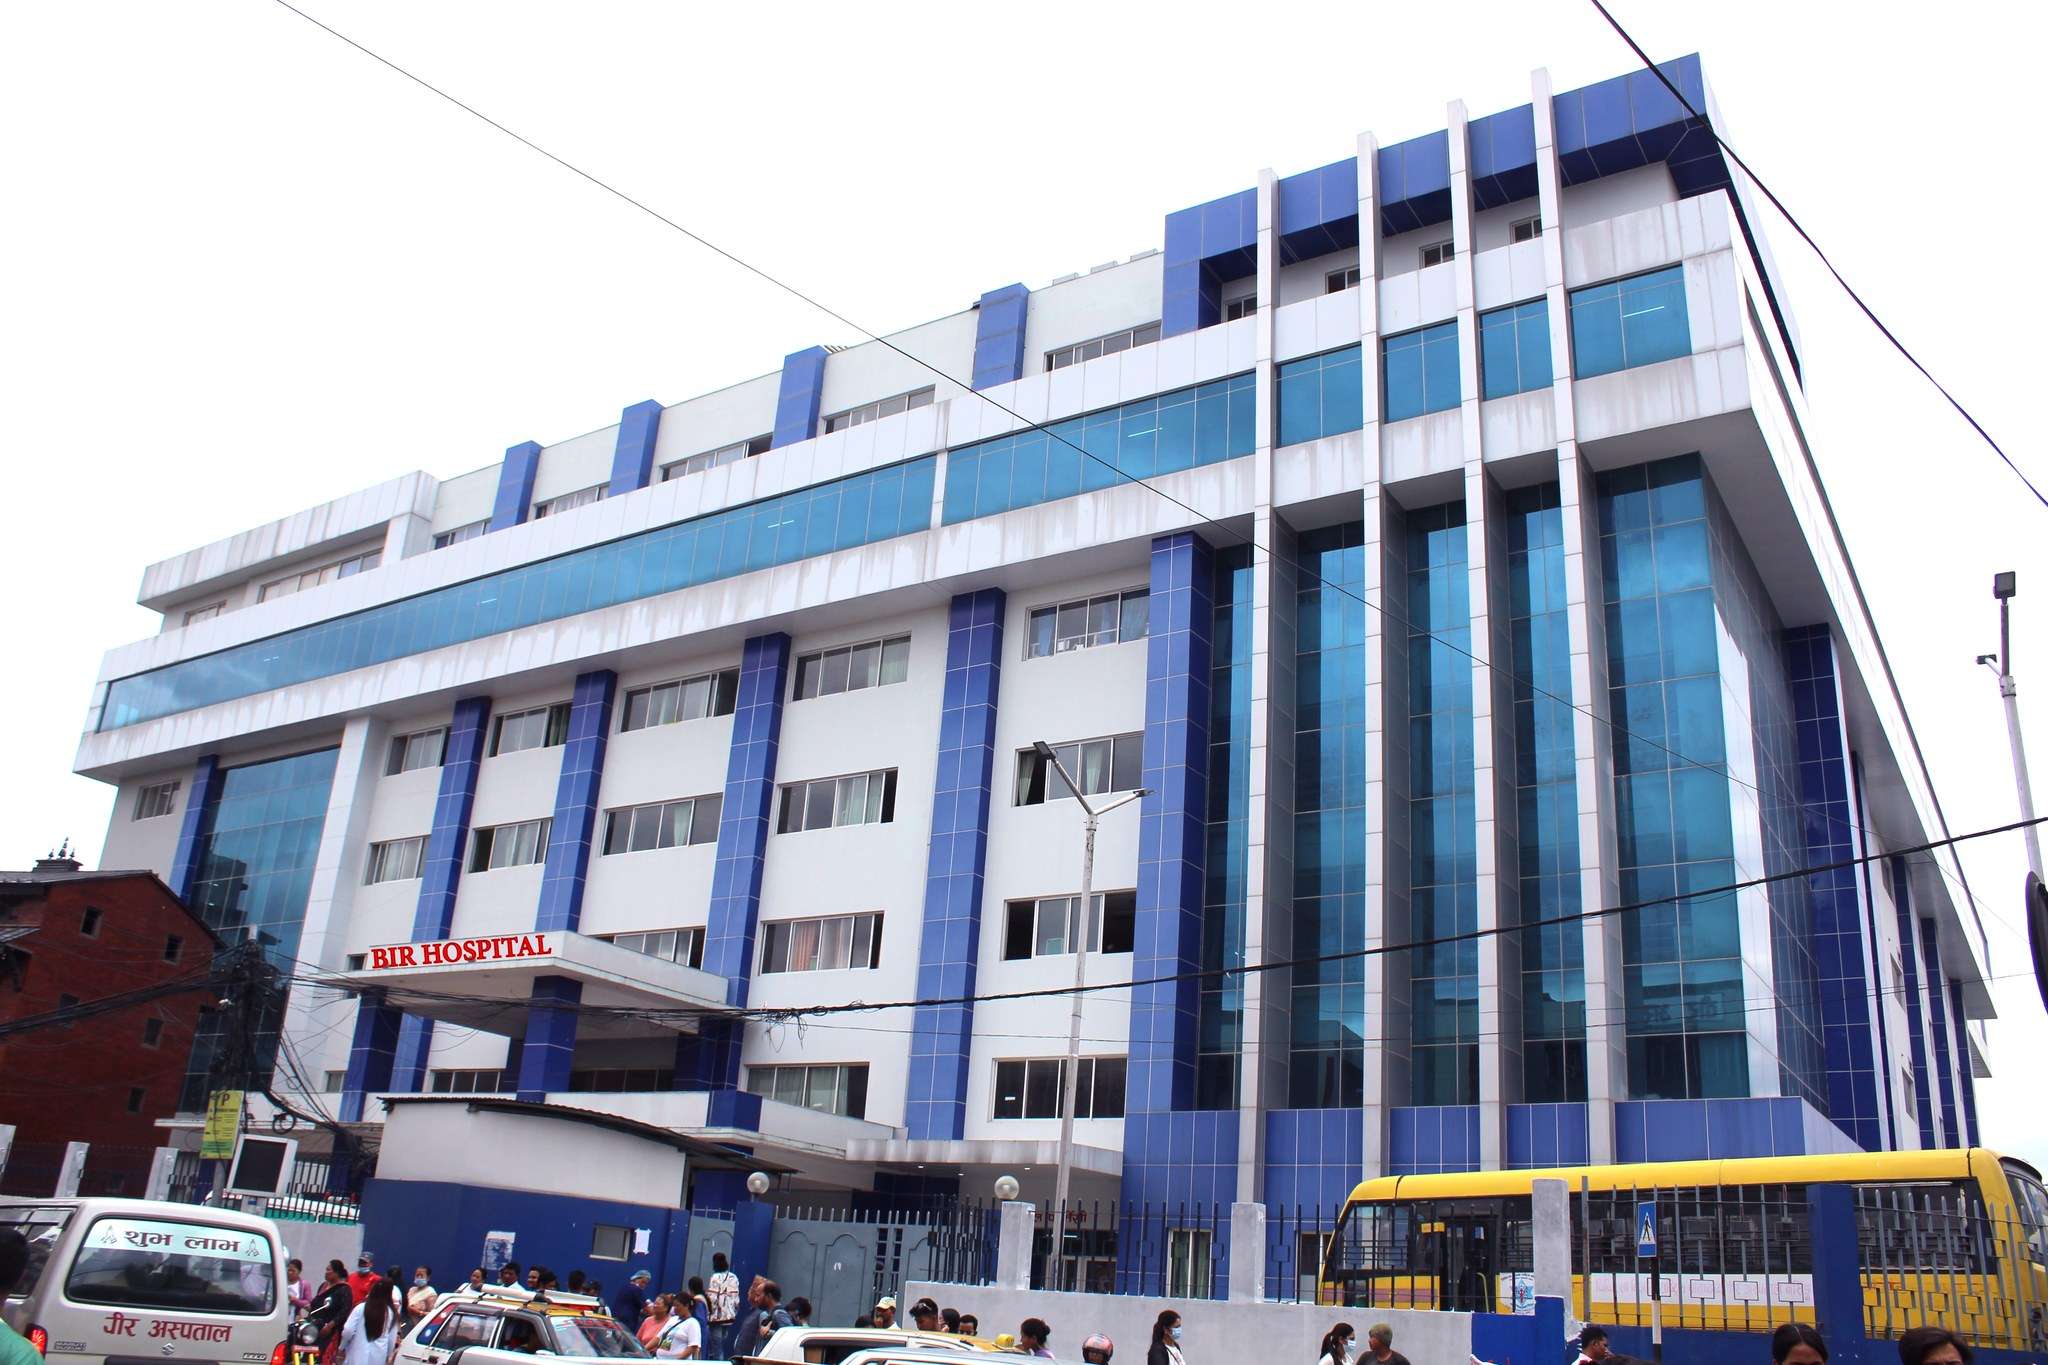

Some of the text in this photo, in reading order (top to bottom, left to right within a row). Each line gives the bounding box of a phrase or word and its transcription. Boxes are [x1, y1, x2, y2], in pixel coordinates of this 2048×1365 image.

[371, 934, 552, 969] BIR HOSPITAL
[124, 1231, 240, 1252] शुभ लाभ
[148, 1320, 232, 1343] अस्पताल
